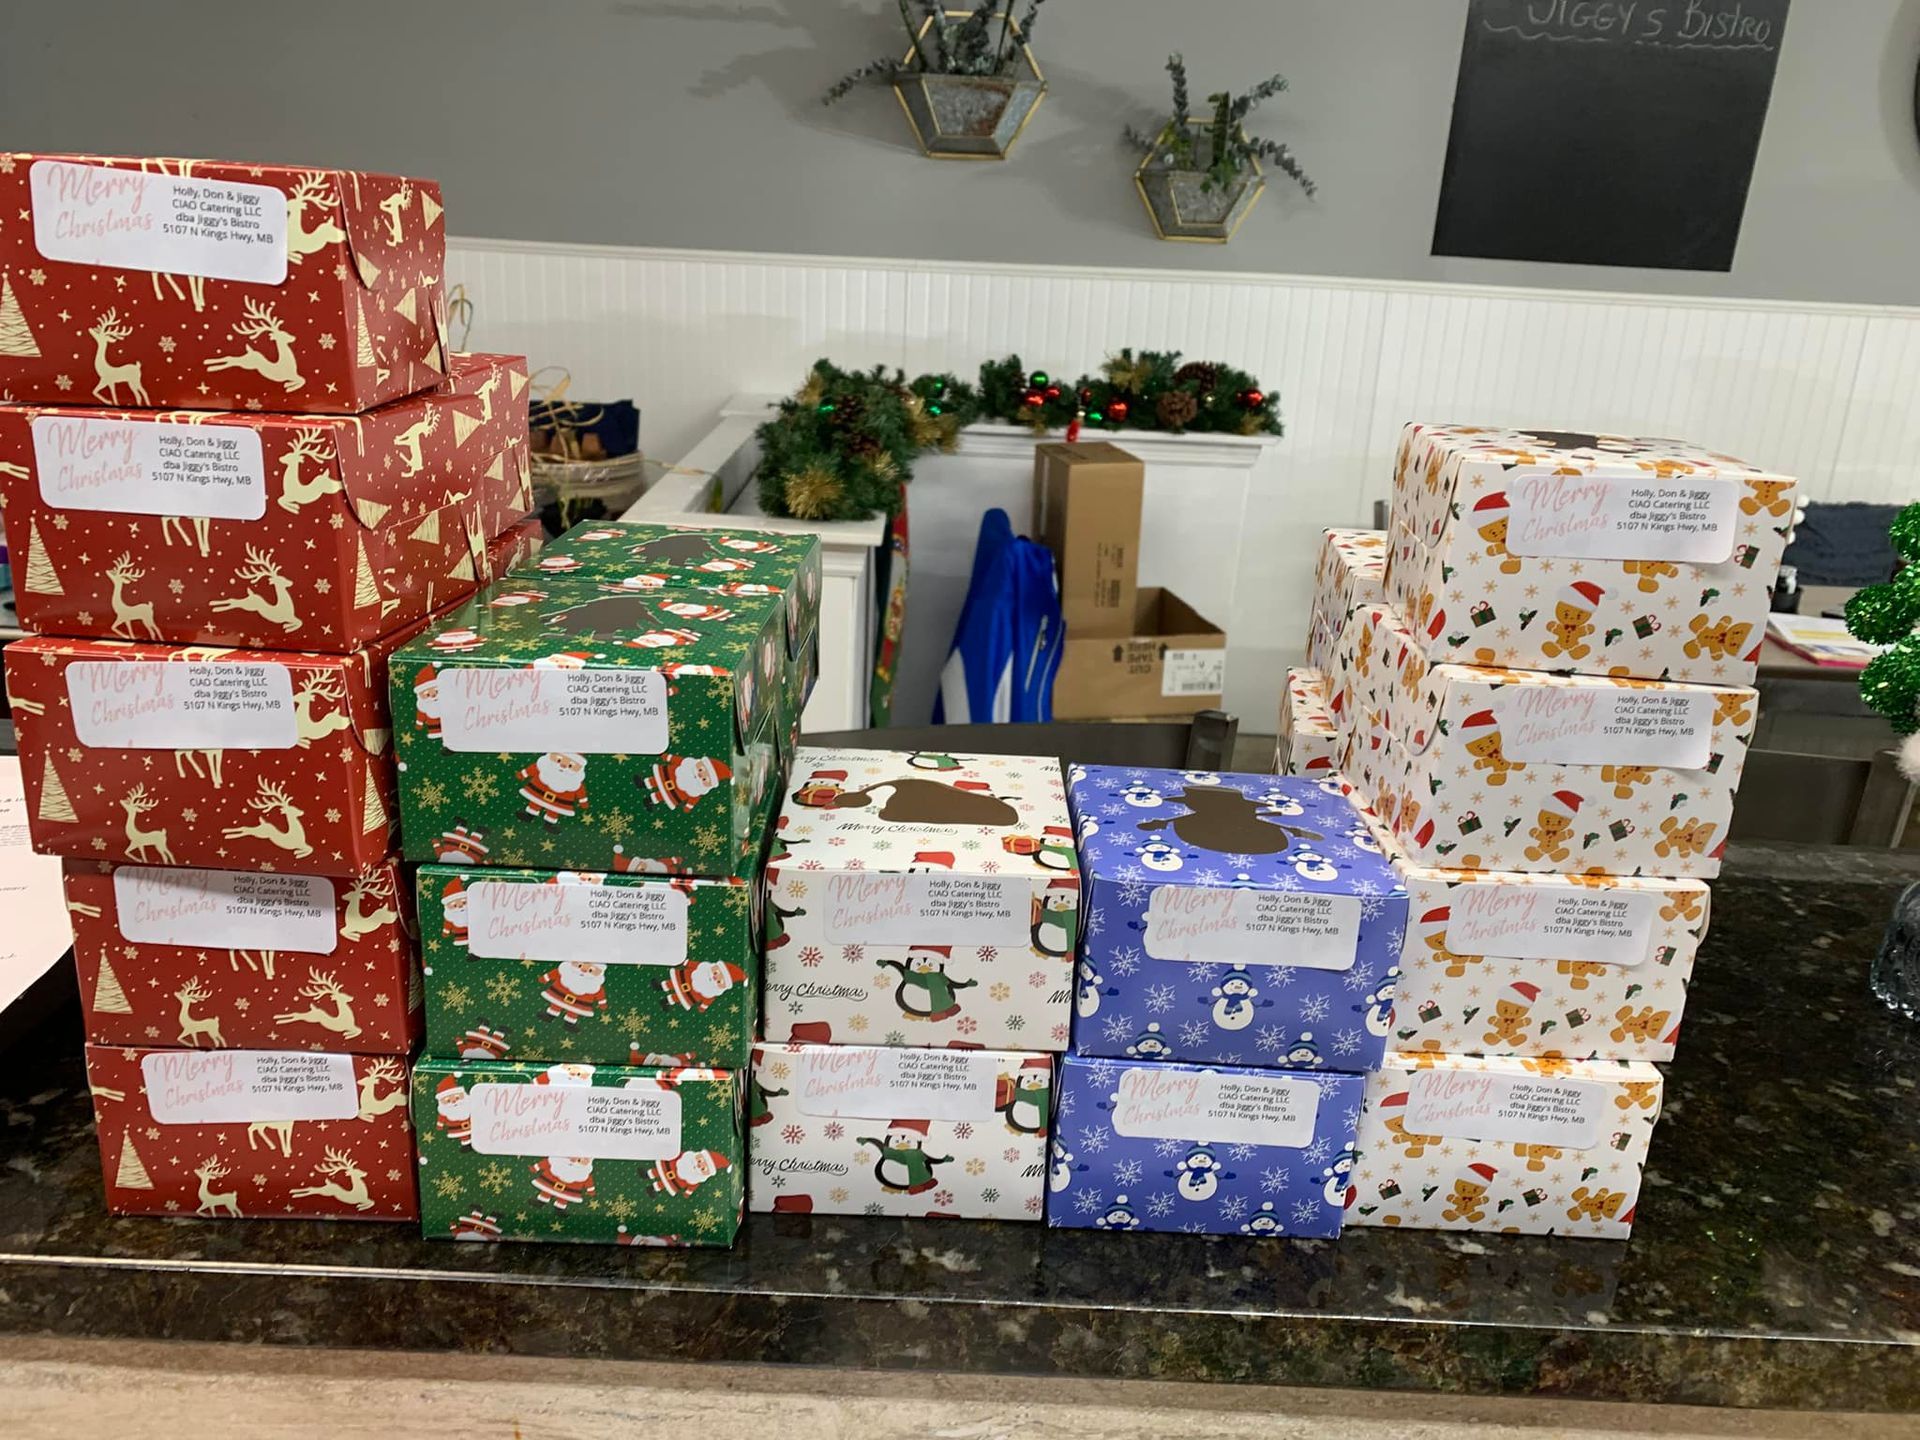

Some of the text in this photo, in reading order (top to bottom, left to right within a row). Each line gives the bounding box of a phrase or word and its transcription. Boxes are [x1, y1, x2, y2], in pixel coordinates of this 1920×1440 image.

[47, 166, 148, 214] Merry
[172, 185, 260, 206] Holly, Don & Jiggy
[171, 197, 262, 217] CIAO Catering LLC
[55, 209, 153, 239] Christmas
[174, 211, 260, 229] dba Jiggy's Bistro
[162, 222, 273, 244] 5107 N Kings Hwy, MB
[46, 420, 137, 464] Merry
[158, 435, 237, 450] Holly, Don & Jiggy
[158, 446, 240, 462] CIAO Catering LLC
[56, 461, 143, 491] Christmas
[162, 459, 239, 473] dba Jiggy's Bistro
[151, 471, 251, 487] 5107 N Kings Hwy, MB
[1521, 477, 1609, 516] Merry
[1627, 498, 1710, 511] CIAO Catering LLC
[1630, 488, 1711, 500] Holly, Don & Jiggy
[1522, 513, 1608, 541] Christmas
[1615, 521, 1717, 533] 5107 N Kings Hwy, MB
[1628, 510, 1706, 522] dba Jiggy's Bistro
[79, 664, 165, 695] Merry
[567, 672, 646, 685] Holly, Don & Jiggy
[1128, 664, 1152, 674] CUT
[455, 669, 542, 702] Merry
[566, 683, 648, 696] CIAO Catering LLC
[92, 693, 174, 724] Christmas
[569, 695, 646, 706] dba Jiggy's Bistro
[1517, 688, 1595, 721] Merry
[464, 699, 550, 730] Christmas
[558, 706, 659, 718] 5107 N Kings Hwy, MB
[1515, 718, 1596, 746] Christmas
[836, 822, 959, 836] Merry Christmas
[125, 869, 210, 898] Merry
[827, 874, 906, 904] Merry
[927, 889, 1002, 900] CIAO Catering LLC
[928, 879, 1001, 890] Holly, Don & Jiggy
[481, 885, 566, 914] Merry
[588, 899, 667, 912] CIAO Catering LLC
[589, 889, 666, 902] Holly, Don & Jiggy
[929, 899, 1000, 909] dba Jiggy's Bistro
[1154, 888, 1236, 917] Merry
[1257, 893, 1332, 907] Holly, Don & Jiggy
[1460, 885, 1537, 920] Merry
[134, 896, 217, 921] Christmas
[591, 909, 665, 921] dba Jiggy's Bistro
[831, 901, 912, 929] Christmas
[919, 908, 1011, 919] 5107 N Kings Hwy, MB
[1255, 903, 1332, 916] CIAO Catering LLC
[1256, 913, 1329, 925] dba Jiggy's Bistro
[488, 911, 572, 938] Christmas
[579, 919, 676, 932] 5107 N Kings Hwy, MB
[1156, 913, 1238, 940] Christmas
[1245, 922, 1339, 936] 5107 N Kings Hwy, MB
[1457, 916, 1537, 941] Christmas
[765, 982, 868, 1002] erry Christmas
[154, 1055, 234, 1082] Merry
[800, 1047, 877, 1076] Merry
[165, 1079, 243, 1108] Christmas
[805, 1071, 882, 1096] Christmas
[1123, 1070, 1199, 1104] Merry
[1416, 1070, 1492, 1103] Merry
[483, 1086, 568, 1119] Merry
[1122, 1100, 1201, 1124] Christmas
[1414, 1099, 1491, 1122] Christmas
[489, 1117, 570, 1141] Christmas
[749, 1157, 849, 1177] erry Christmas
